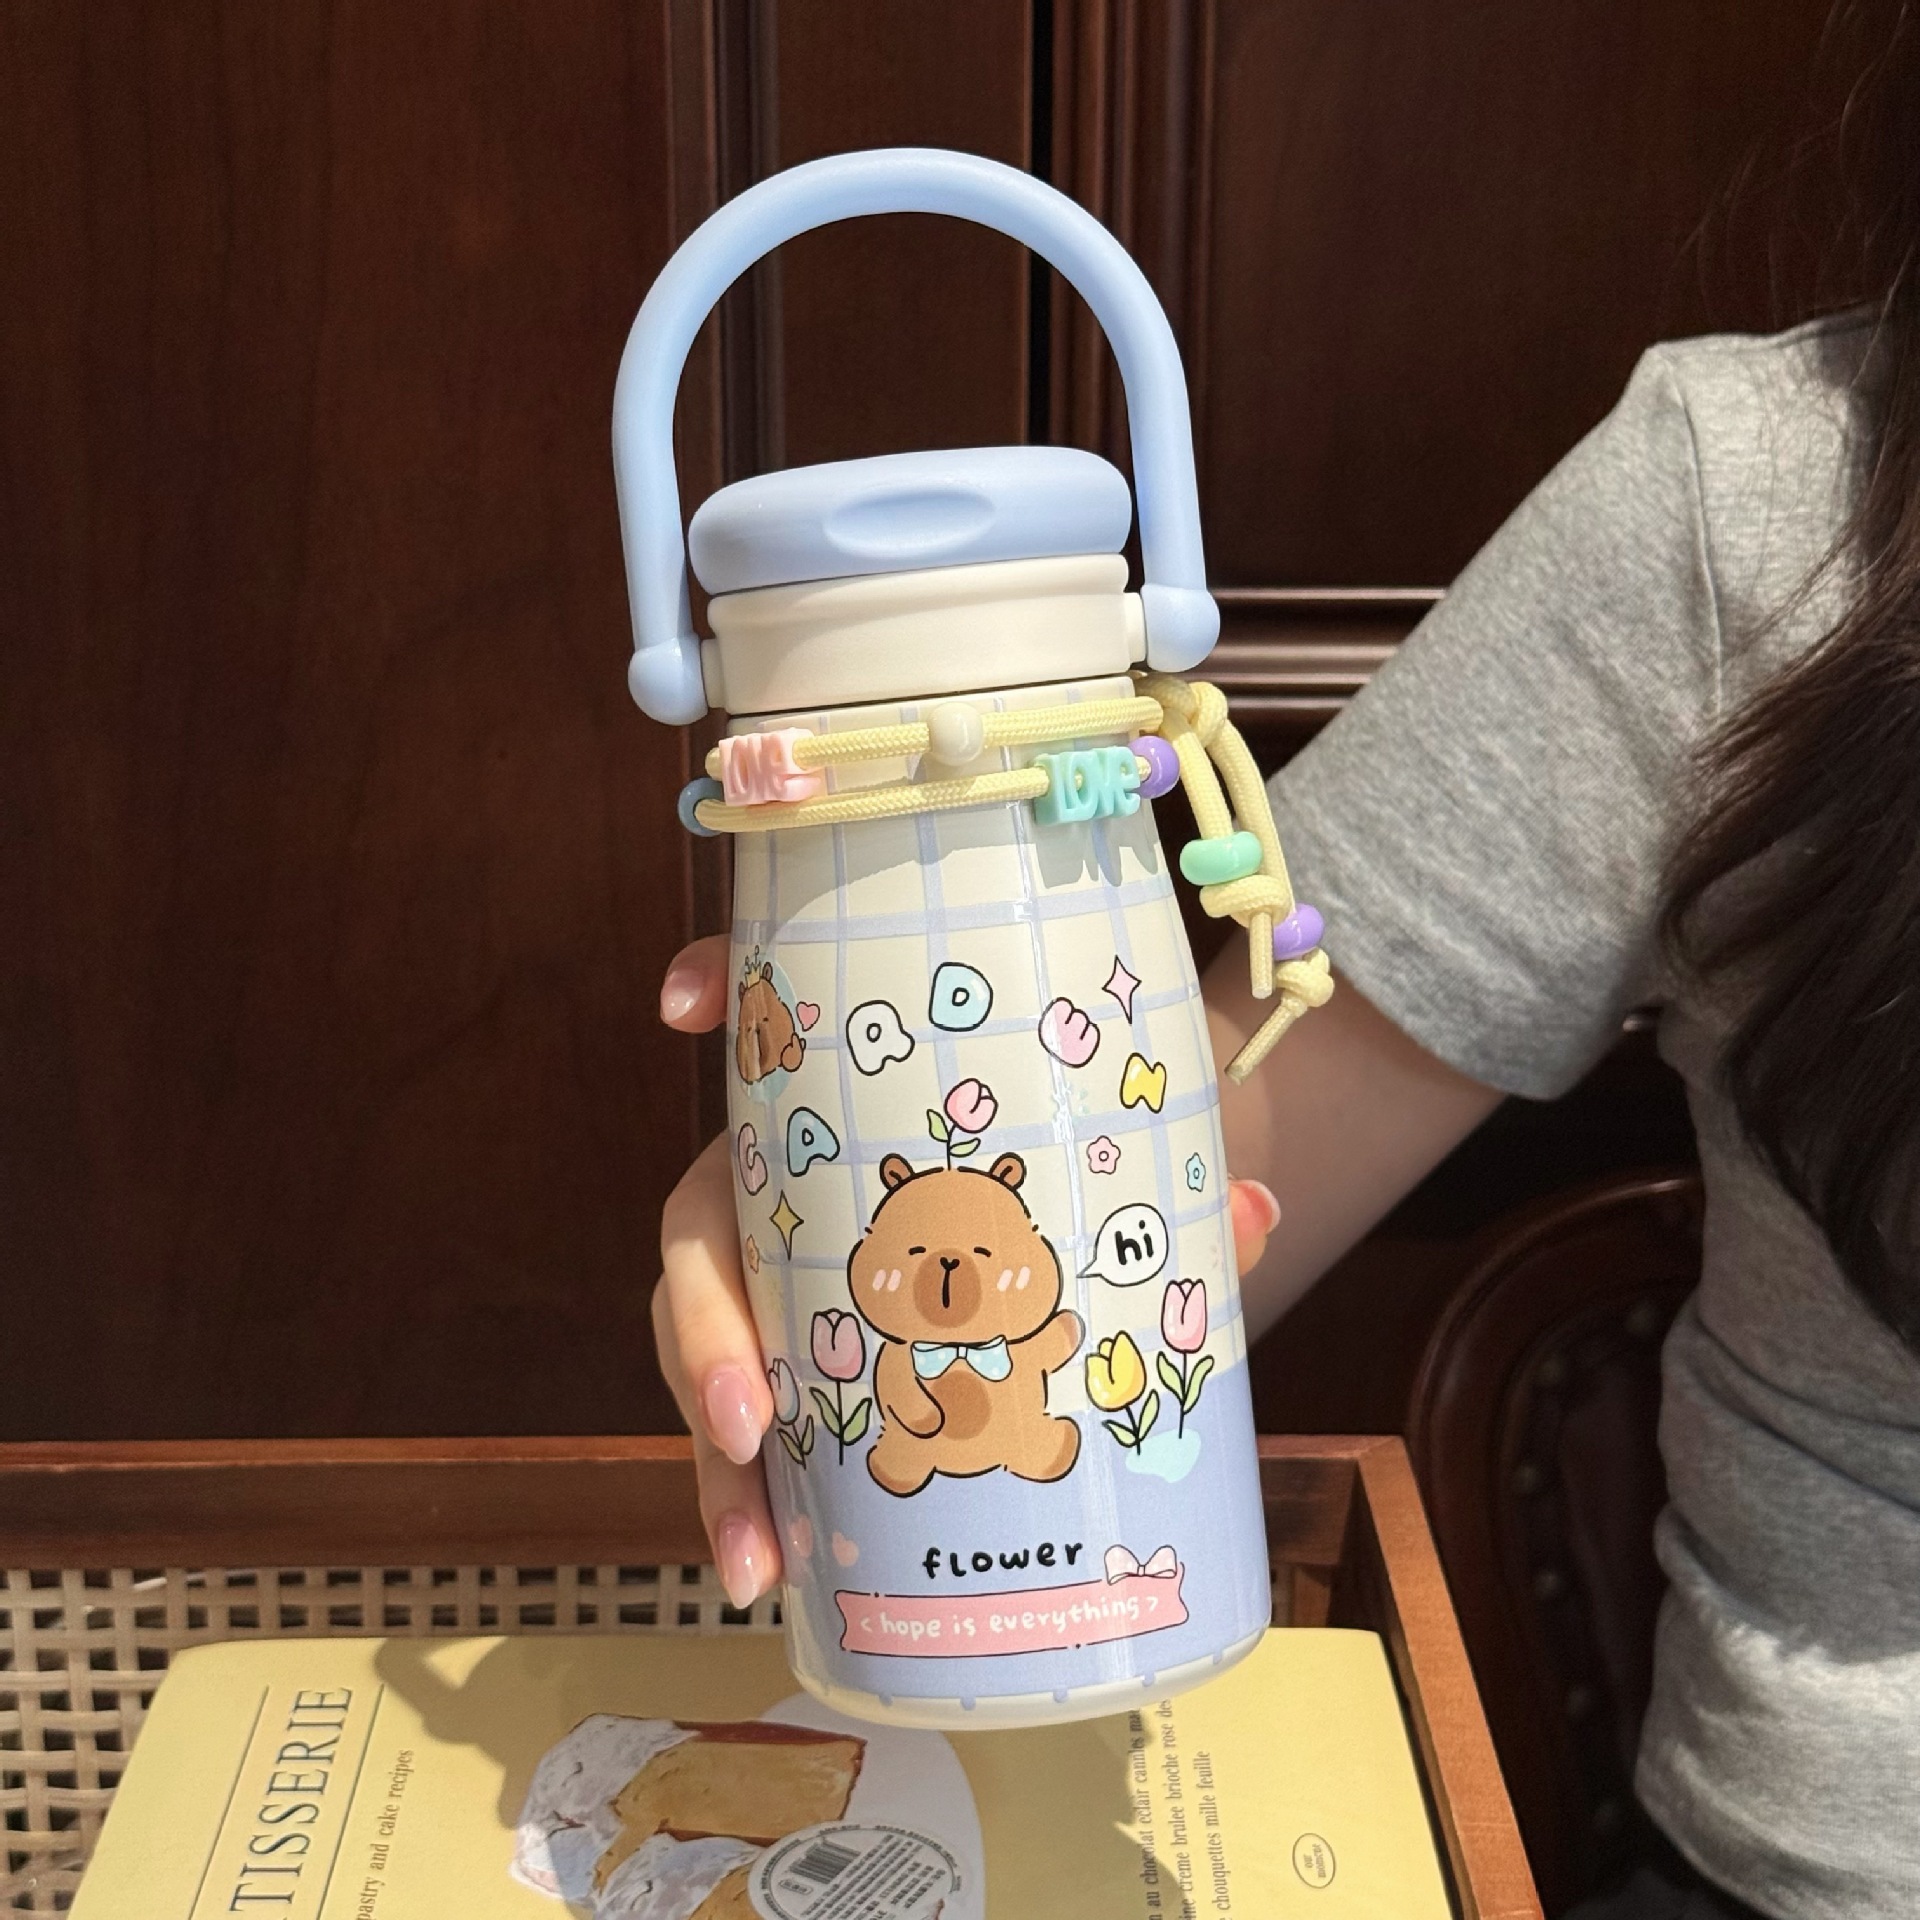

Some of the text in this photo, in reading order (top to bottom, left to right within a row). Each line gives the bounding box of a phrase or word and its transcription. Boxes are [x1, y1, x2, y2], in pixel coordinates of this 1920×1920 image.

[1114, 1219, 1154, 1266] hi
[922, 1542, 1083, 1579] flower
[880, 1612, 942, 1641] hope
[953, 1615, 977, 1636] is
[990, 1598, 1140, 1634] everything
[1161, 1723, 1176, 1748] rose
[1161, 1754, 1182, 1799] brioche
[1192, 1751, 1214, 1789] feuille
[229, 1687, 353, 1920] TISSERIE
[1132, 1788, 1152, 1824] eclair
[1198, 1795, 1219, 1826] mille
[356, 1749, 415, 1920] pastry and cake recipes
[1168, 1806, 1188, 1845] brulee
[1138, 1830, 1158, 1885] chocolat
[1176, 1852, 1194, 1892] creme
[1207, 1832, 1231, 1910] chouquettes
[1146, 1891, 1161, 1907] au
